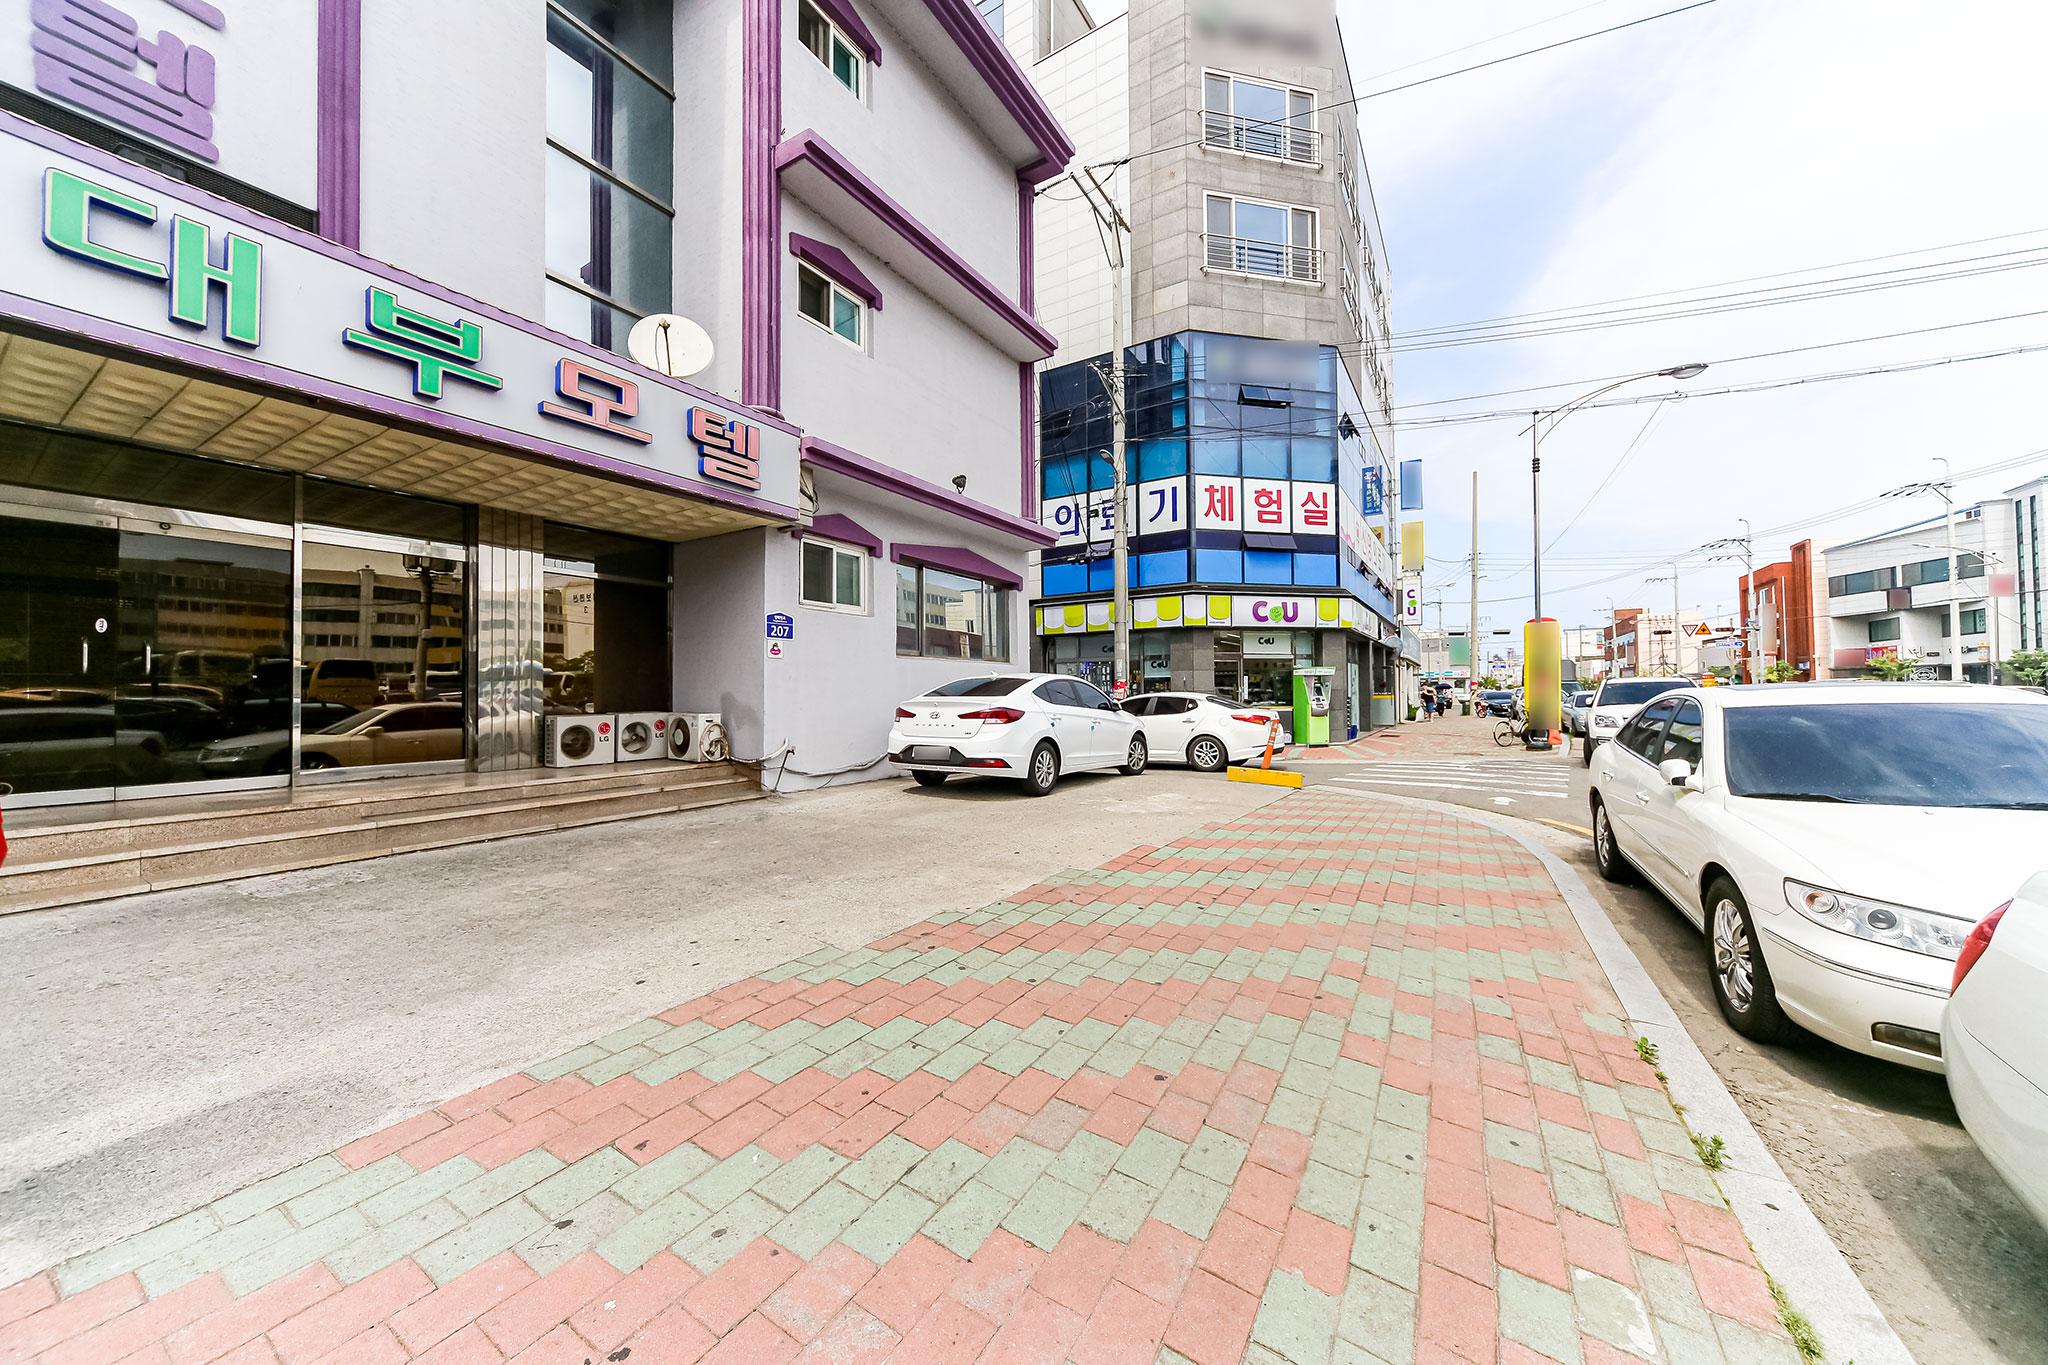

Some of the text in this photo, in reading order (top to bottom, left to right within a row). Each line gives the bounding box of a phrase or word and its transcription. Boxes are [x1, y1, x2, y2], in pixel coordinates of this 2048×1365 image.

[1204, 484, 1329, 527] 체험실
[1407, 589, 1417, 616] CU
[1252, 600, 1299, 623] CU
[770, 625, 790, 637] 207
[1257, 636, 1275, 646] CU
[599, 735, 609, 743] LG
[655, 731, 665, 739] LG
